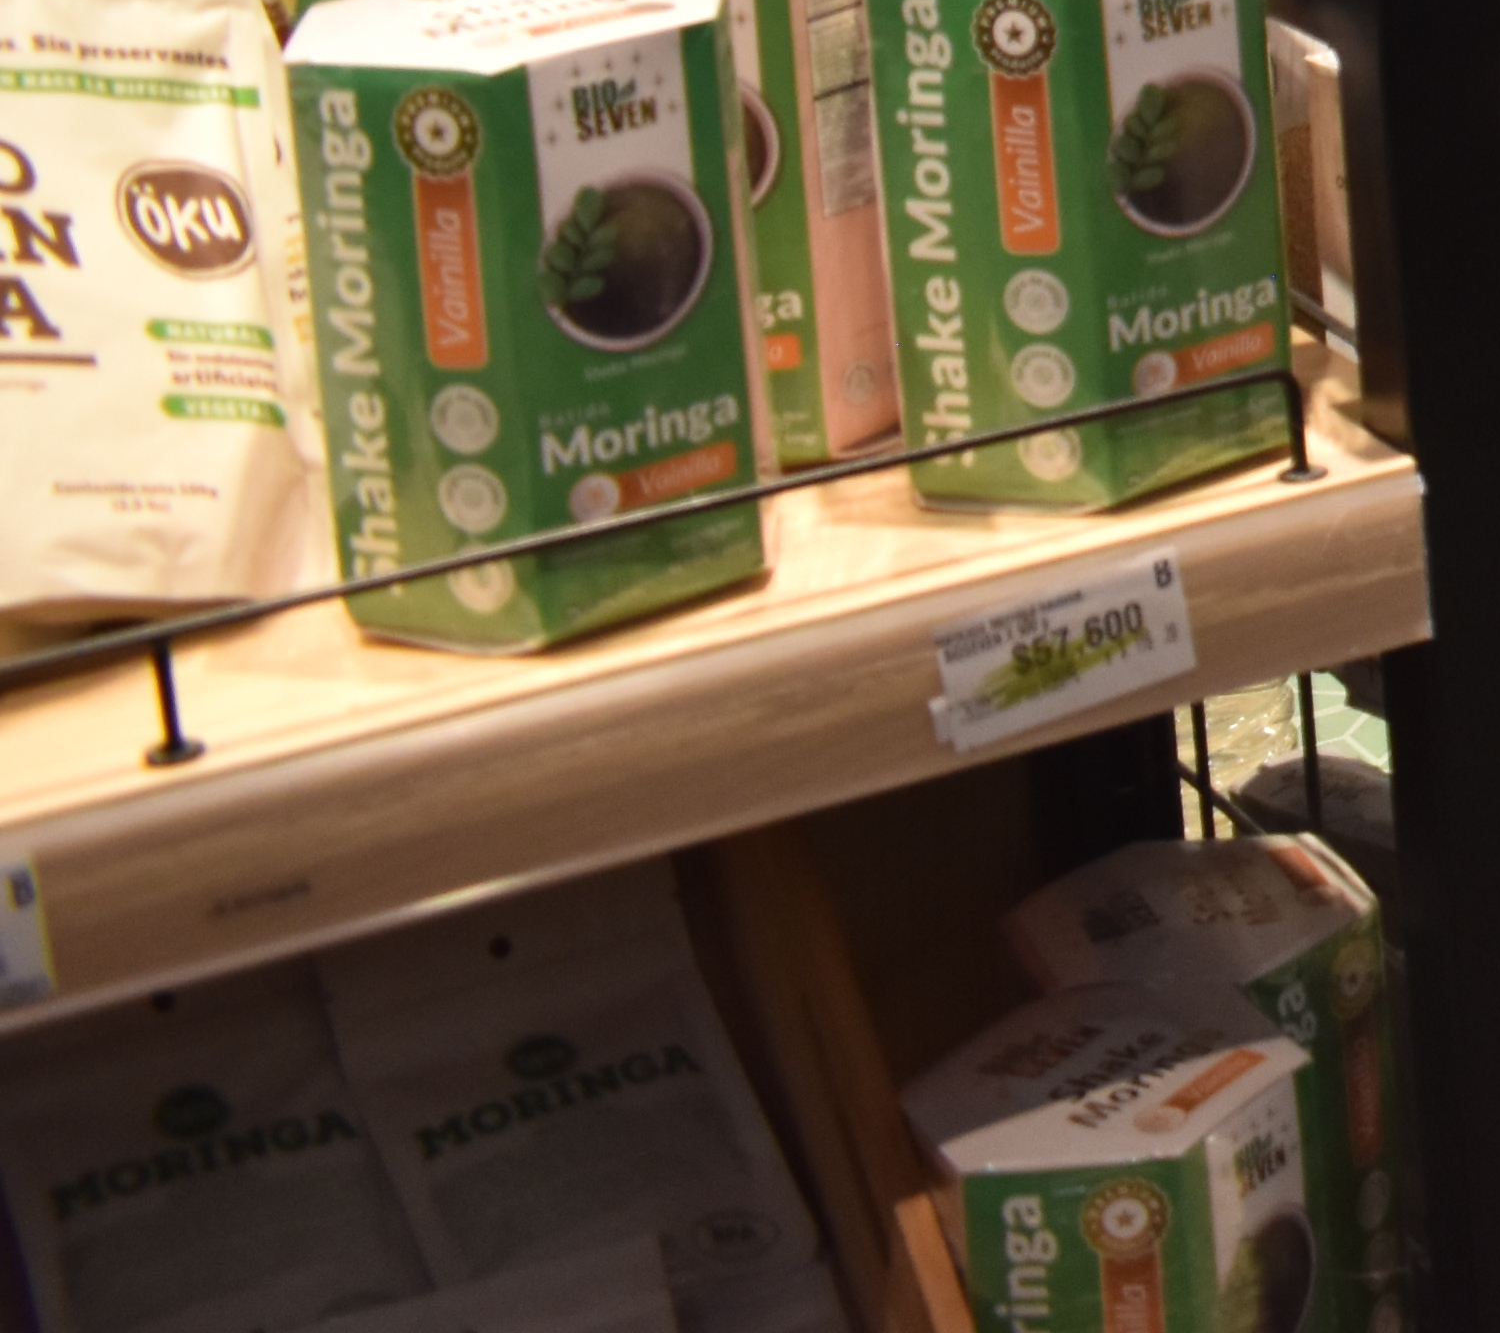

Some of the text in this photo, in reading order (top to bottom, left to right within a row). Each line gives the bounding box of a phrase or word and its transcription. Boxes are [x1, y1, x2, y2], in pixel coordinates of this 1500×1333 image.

[571, 81, 618, 116] BIO
[1008, 103, 1043, 236] Vainilla
[319, 86, 382, 378] Moringa
[431, 206, 468, 348] Vainilla
[1107, 275, 1278, 353] Moringa
[540, 392, 740, 476] Moringa
[419, 1043, 704, 1158] MORINGA
[53, 1108, 358, 1221] MORINGA
